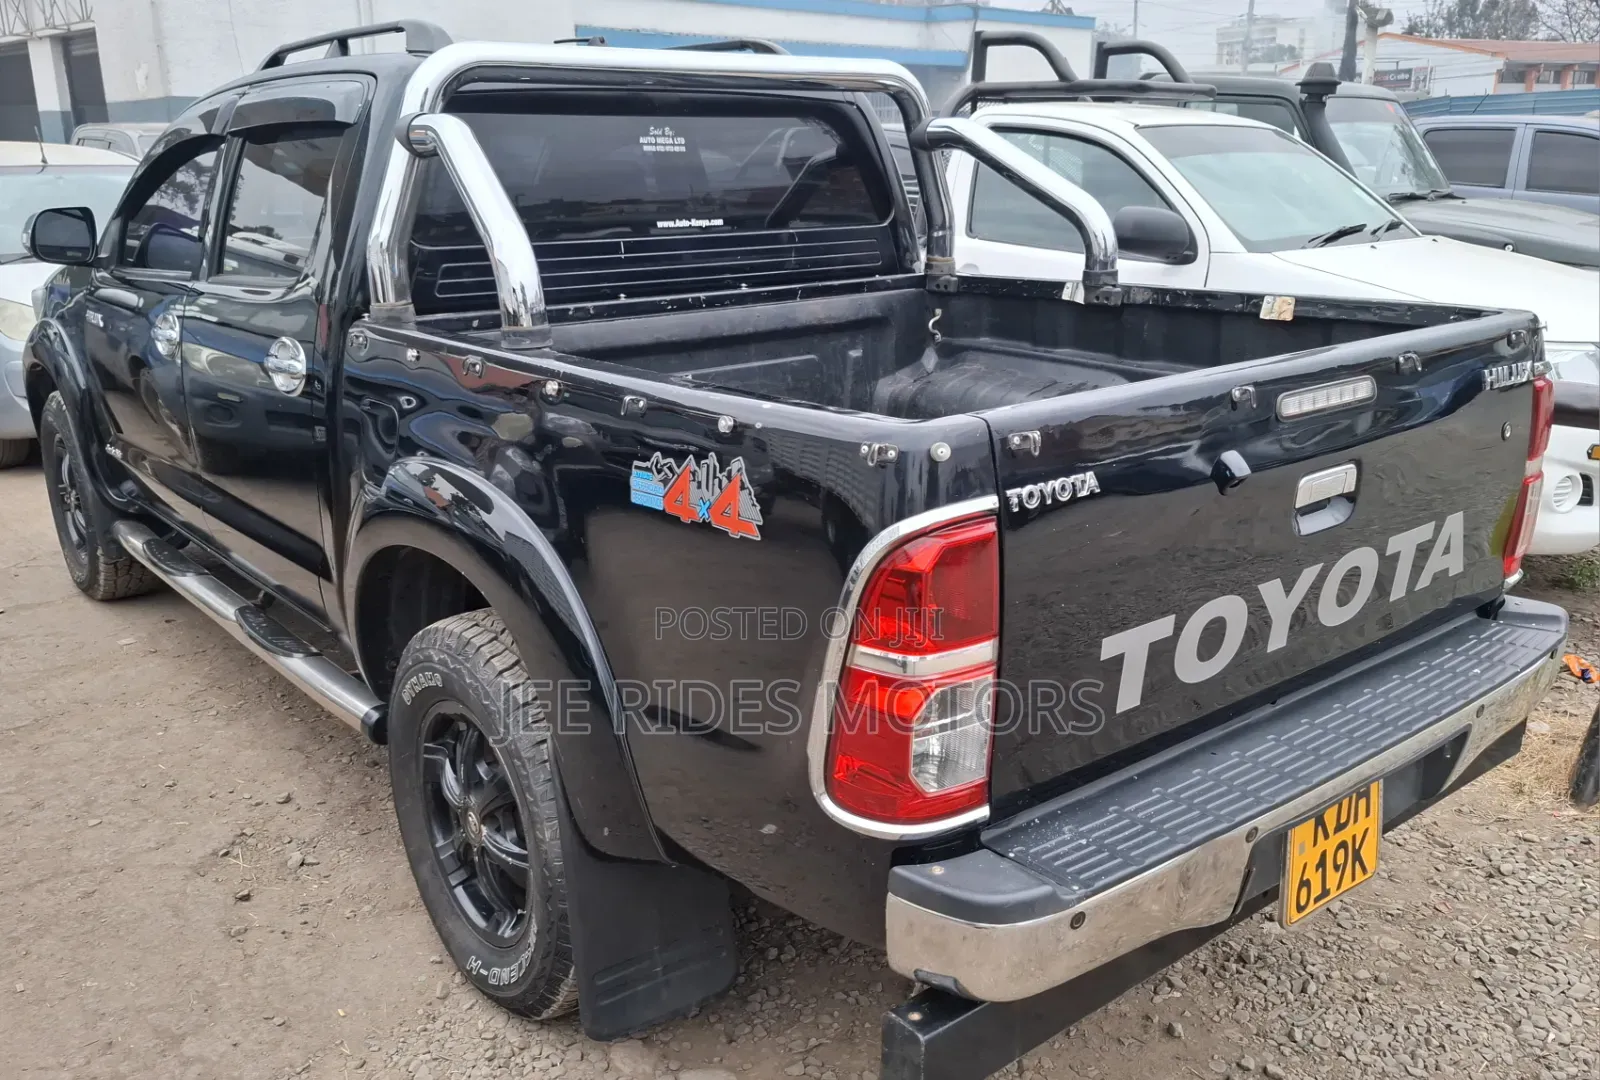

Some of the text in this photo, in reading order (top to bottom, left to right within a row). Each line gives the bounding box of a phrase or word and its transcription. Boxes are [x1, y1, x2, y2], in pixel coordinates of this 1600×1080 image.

[639, 136, 686, 145] AUTO MEGA LTD
[1005, 471, 1101, 513] TOYOTA
[1100, 511, 1464, 714] TOYOTA
[402, 671, 443, 706] DYNAMO
[1296, 826, 1370, 914] 619K
